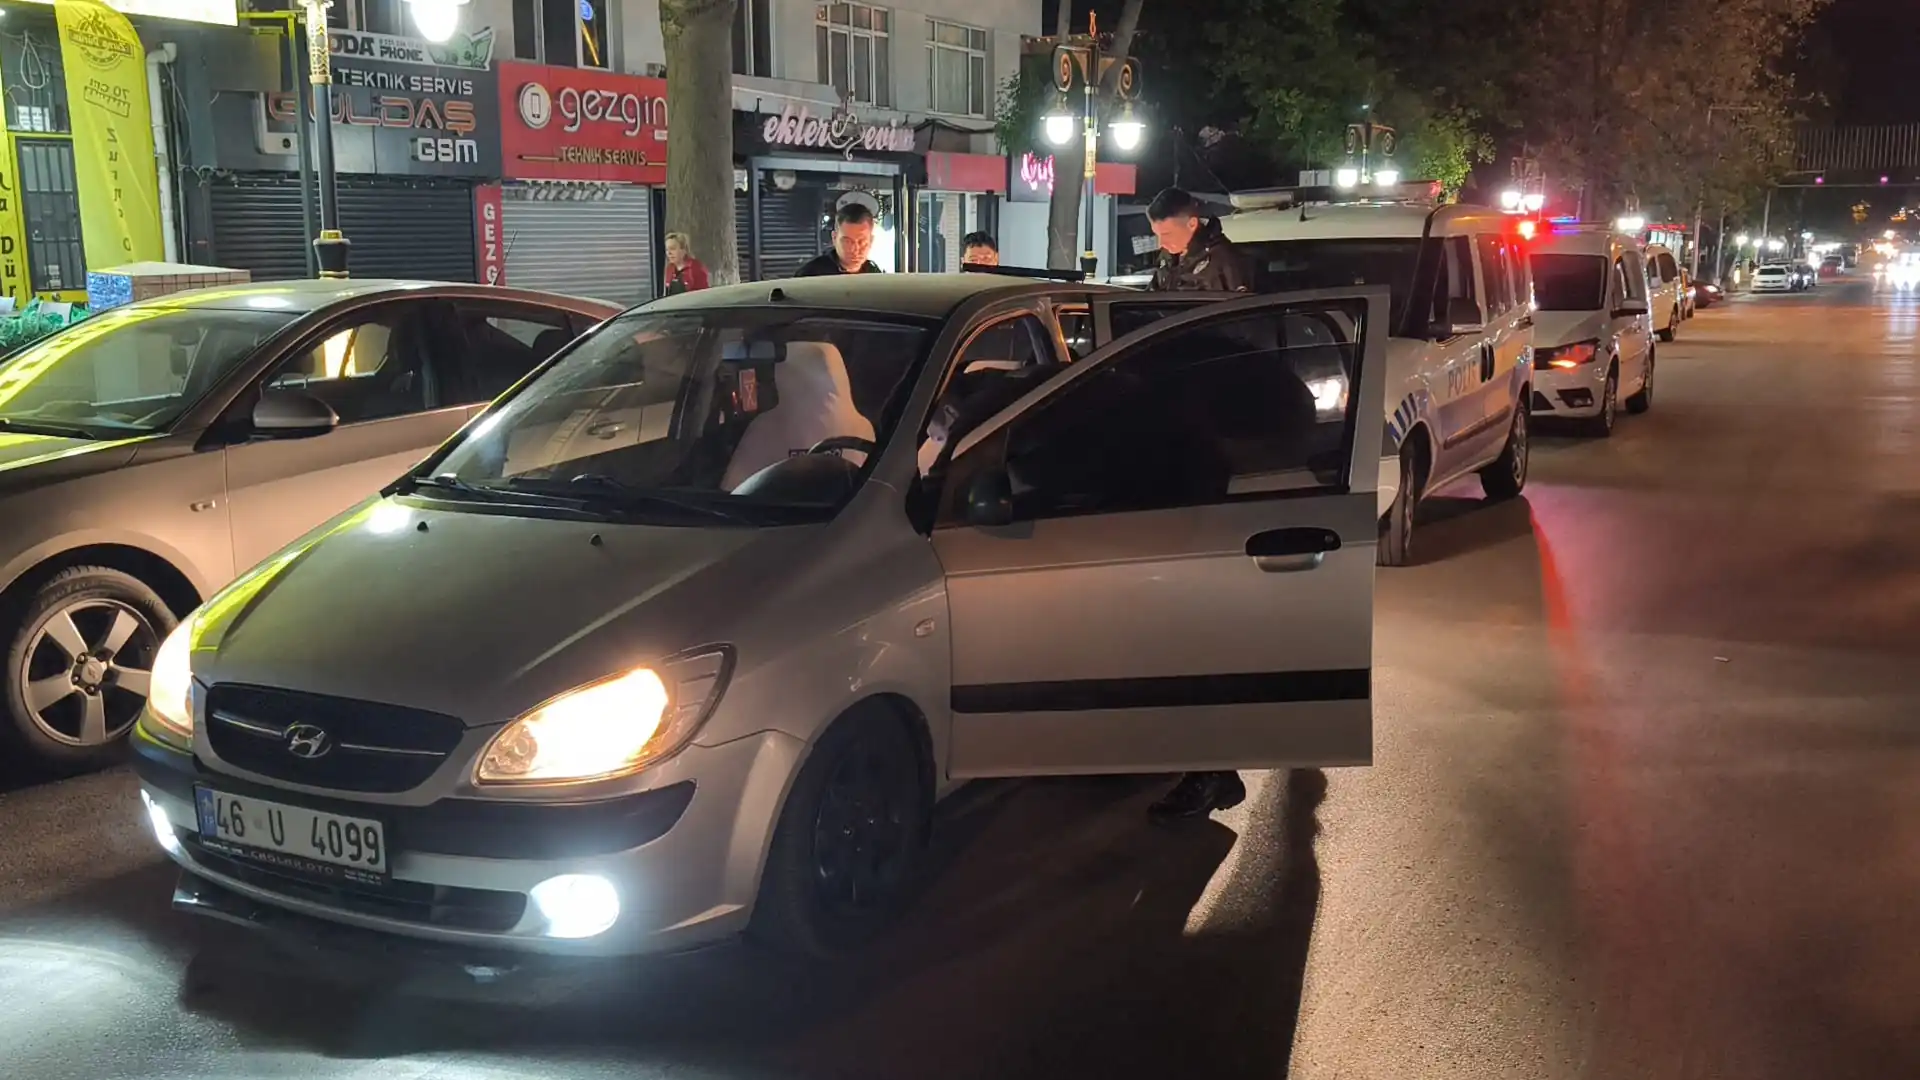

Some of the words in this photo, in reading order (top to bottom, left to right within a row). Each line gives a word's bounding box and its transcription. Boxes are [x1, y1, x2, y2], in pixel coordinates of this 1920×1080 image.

[327, 33, 375, 57] ODA
[379, 45, 424, 62] PHONE
[418, 137, 478, 163] GSM
[217, 798, 245, 837] 46
[268, 809, 284, 847] U
[311, 816, 380, 866] 4099
